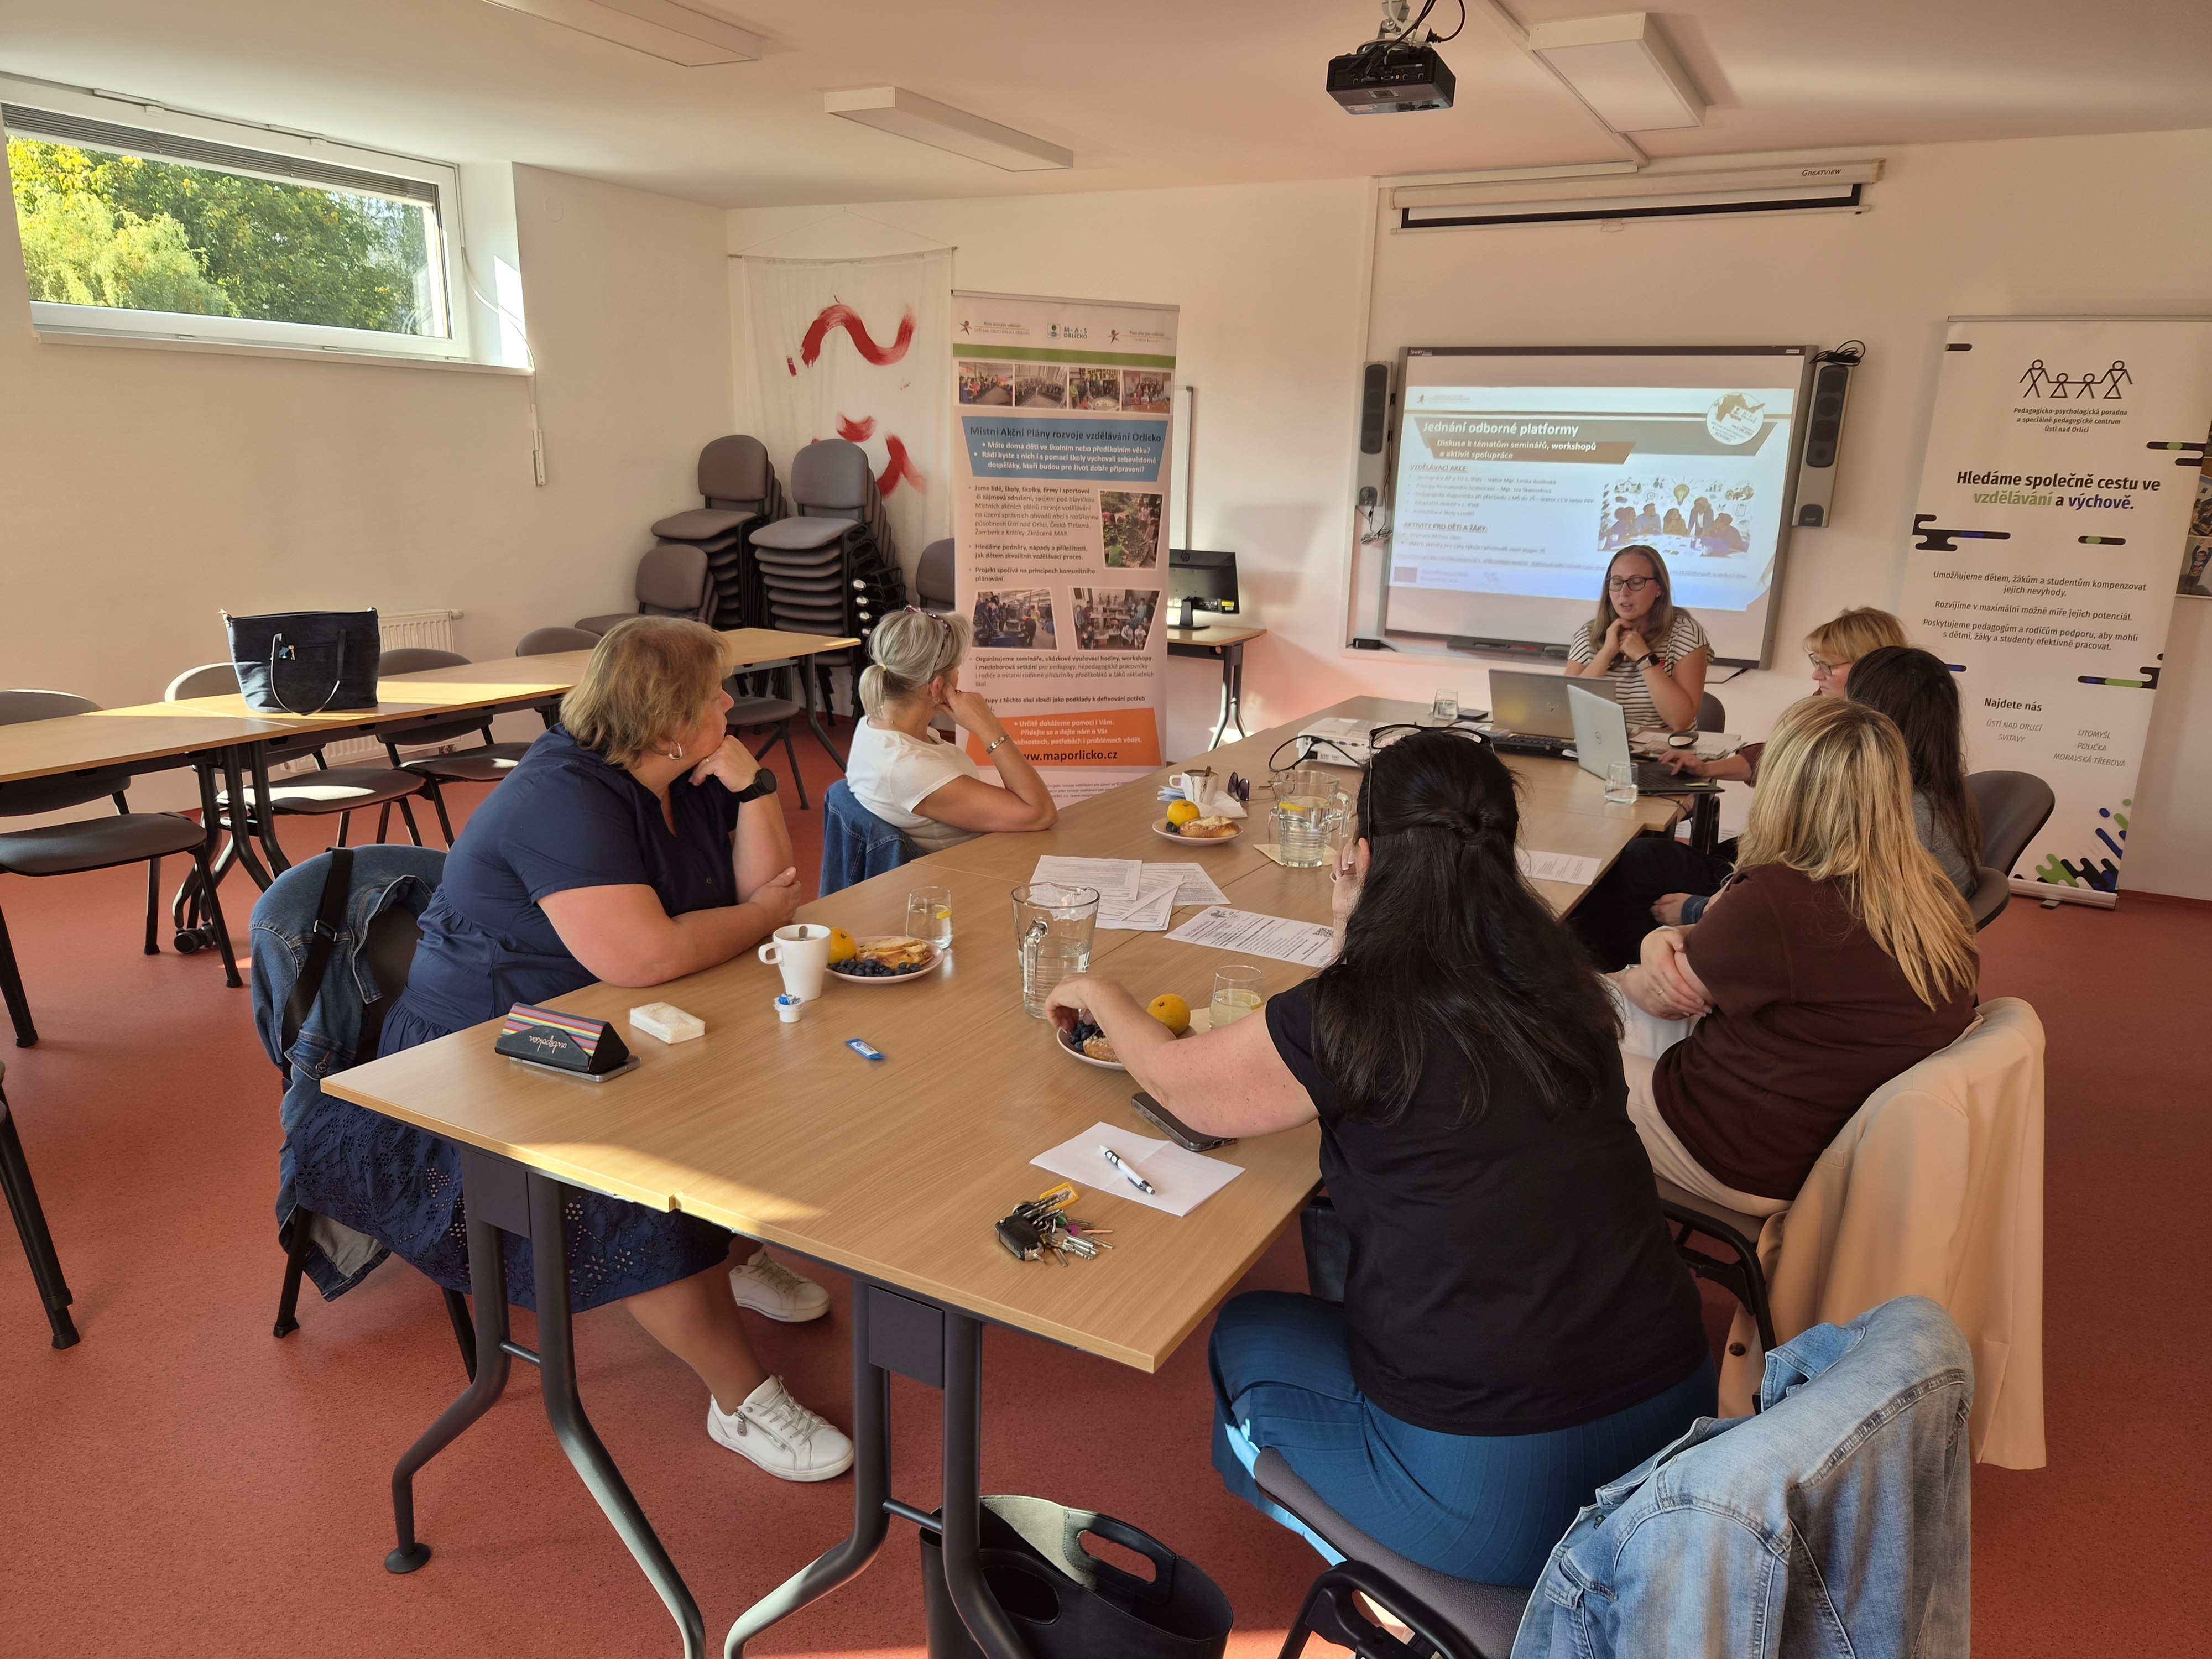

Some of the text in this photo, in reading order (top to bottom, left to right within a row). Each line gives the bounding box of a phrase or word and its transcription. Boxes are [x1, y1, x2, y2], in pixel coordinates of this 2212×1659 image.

[2013, 407, 2099, 416] Pedagogicko-psychologická
[1026, 429, 1051, 440] Plány
[1423, 422, 1465, 433] Jednání
[1519, 424, 1579, 437] platformy
[1957, 471, 2160, 491] Hledáme společně cestu ve
[1974, 491, 2134, 511] vzdělávání a výchově.
[1933, 570, 1983, 583] Umožňujeme
[1984, 573, 2010, 585] dětem,
[2012, 575, 2038, 585] žákům
[2047, 578, 2090, 588] studentům
[2091, 580, 2146, 591] kompenzovat
[2003, 585, 2067, 598] jejich nevýhody.
[1935, 599, 1971, 612] Rozvíjíme
[1979, 603, 2020, 613] maximální
[2020, 606, 2047, 615] možné
[2048, 608, 2067, 617] míře
[2068, 608, 2090, 619] jejich
[2091, 612, 2132, 621] potenciál.
[1923, 617, 1970, 630] Poskytujeme
[1971, 622, 2017, 634] pedagogům
[2025, 625, 2058, 635] rodičům
[2059, 628, 2095, 640] podporu,
[2098, 631, 2113, 642] aby
[2114, 633, 2138, 642] mohli
[1948, 630, 1972, 641] dětmi,
[1974, 632, 1991, 644] žáky
[2000, 635, 2034, 647] studenty
[2036, 637, 2073, 648] efektivně
[2074, 641, 2111, 651] pracovat.
[1984, 697, 2042, 712] Najdete nás
[1986, 718, 2042, 731] ÚSTÍ NAD ORLICÍ
[1998, 732, 2026, 743] SVITAVY
[2078, 728, 2111, 739] LITOMYŠL
[2077, 742, 2106, 752] POLIČKA
[2053, 753, 2125, 768] MORAVSKÁ TŘEBOVÁ
[529, 1035, 567, 1054] outspoken
